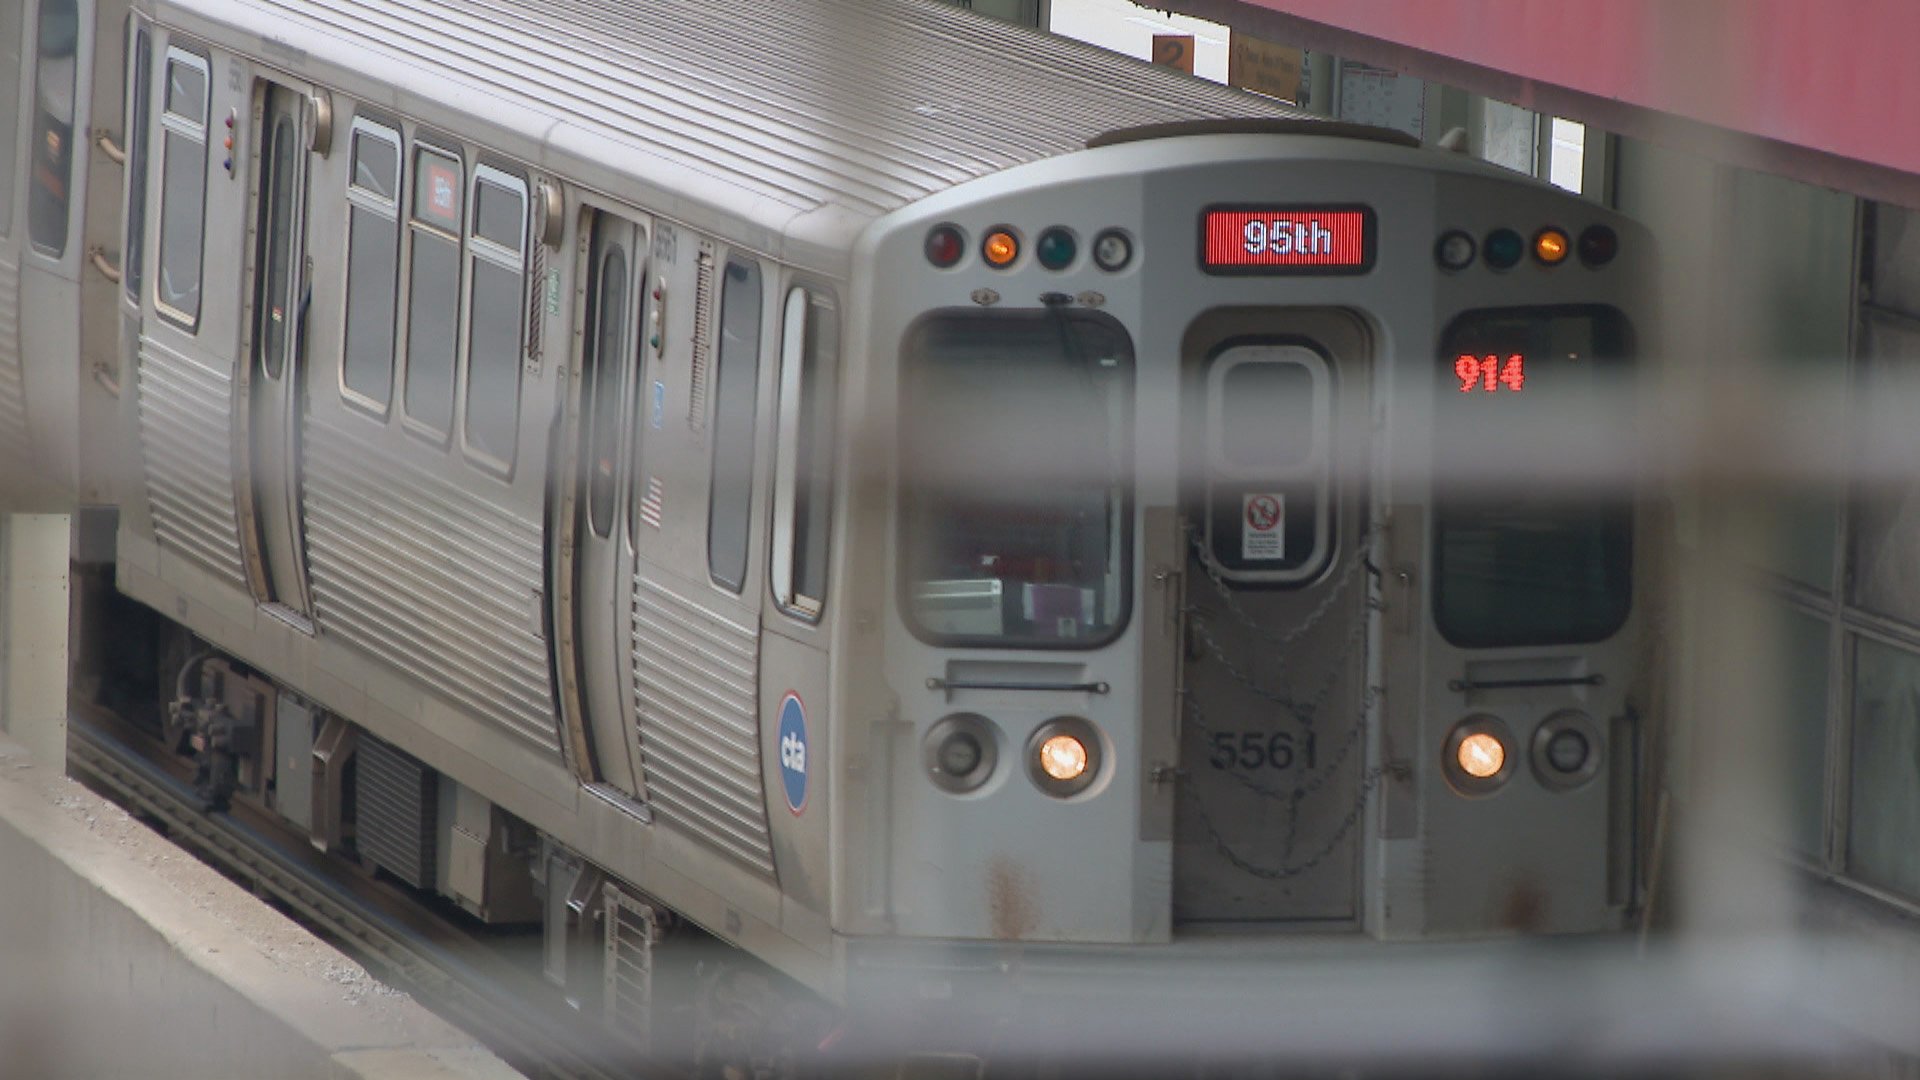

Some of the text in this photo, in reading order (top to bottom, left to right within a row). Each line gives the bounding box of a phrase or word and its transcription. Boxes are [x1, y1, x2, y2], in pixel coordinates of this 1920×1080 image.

[1160, 41, 1184, 70] 2
[1244, 220, 1332, 255] 95th
[1454, 354, 1525, 392] 914
[781, 731, 806, 774] cta
[1209, 730, 1317, 770] 5561
